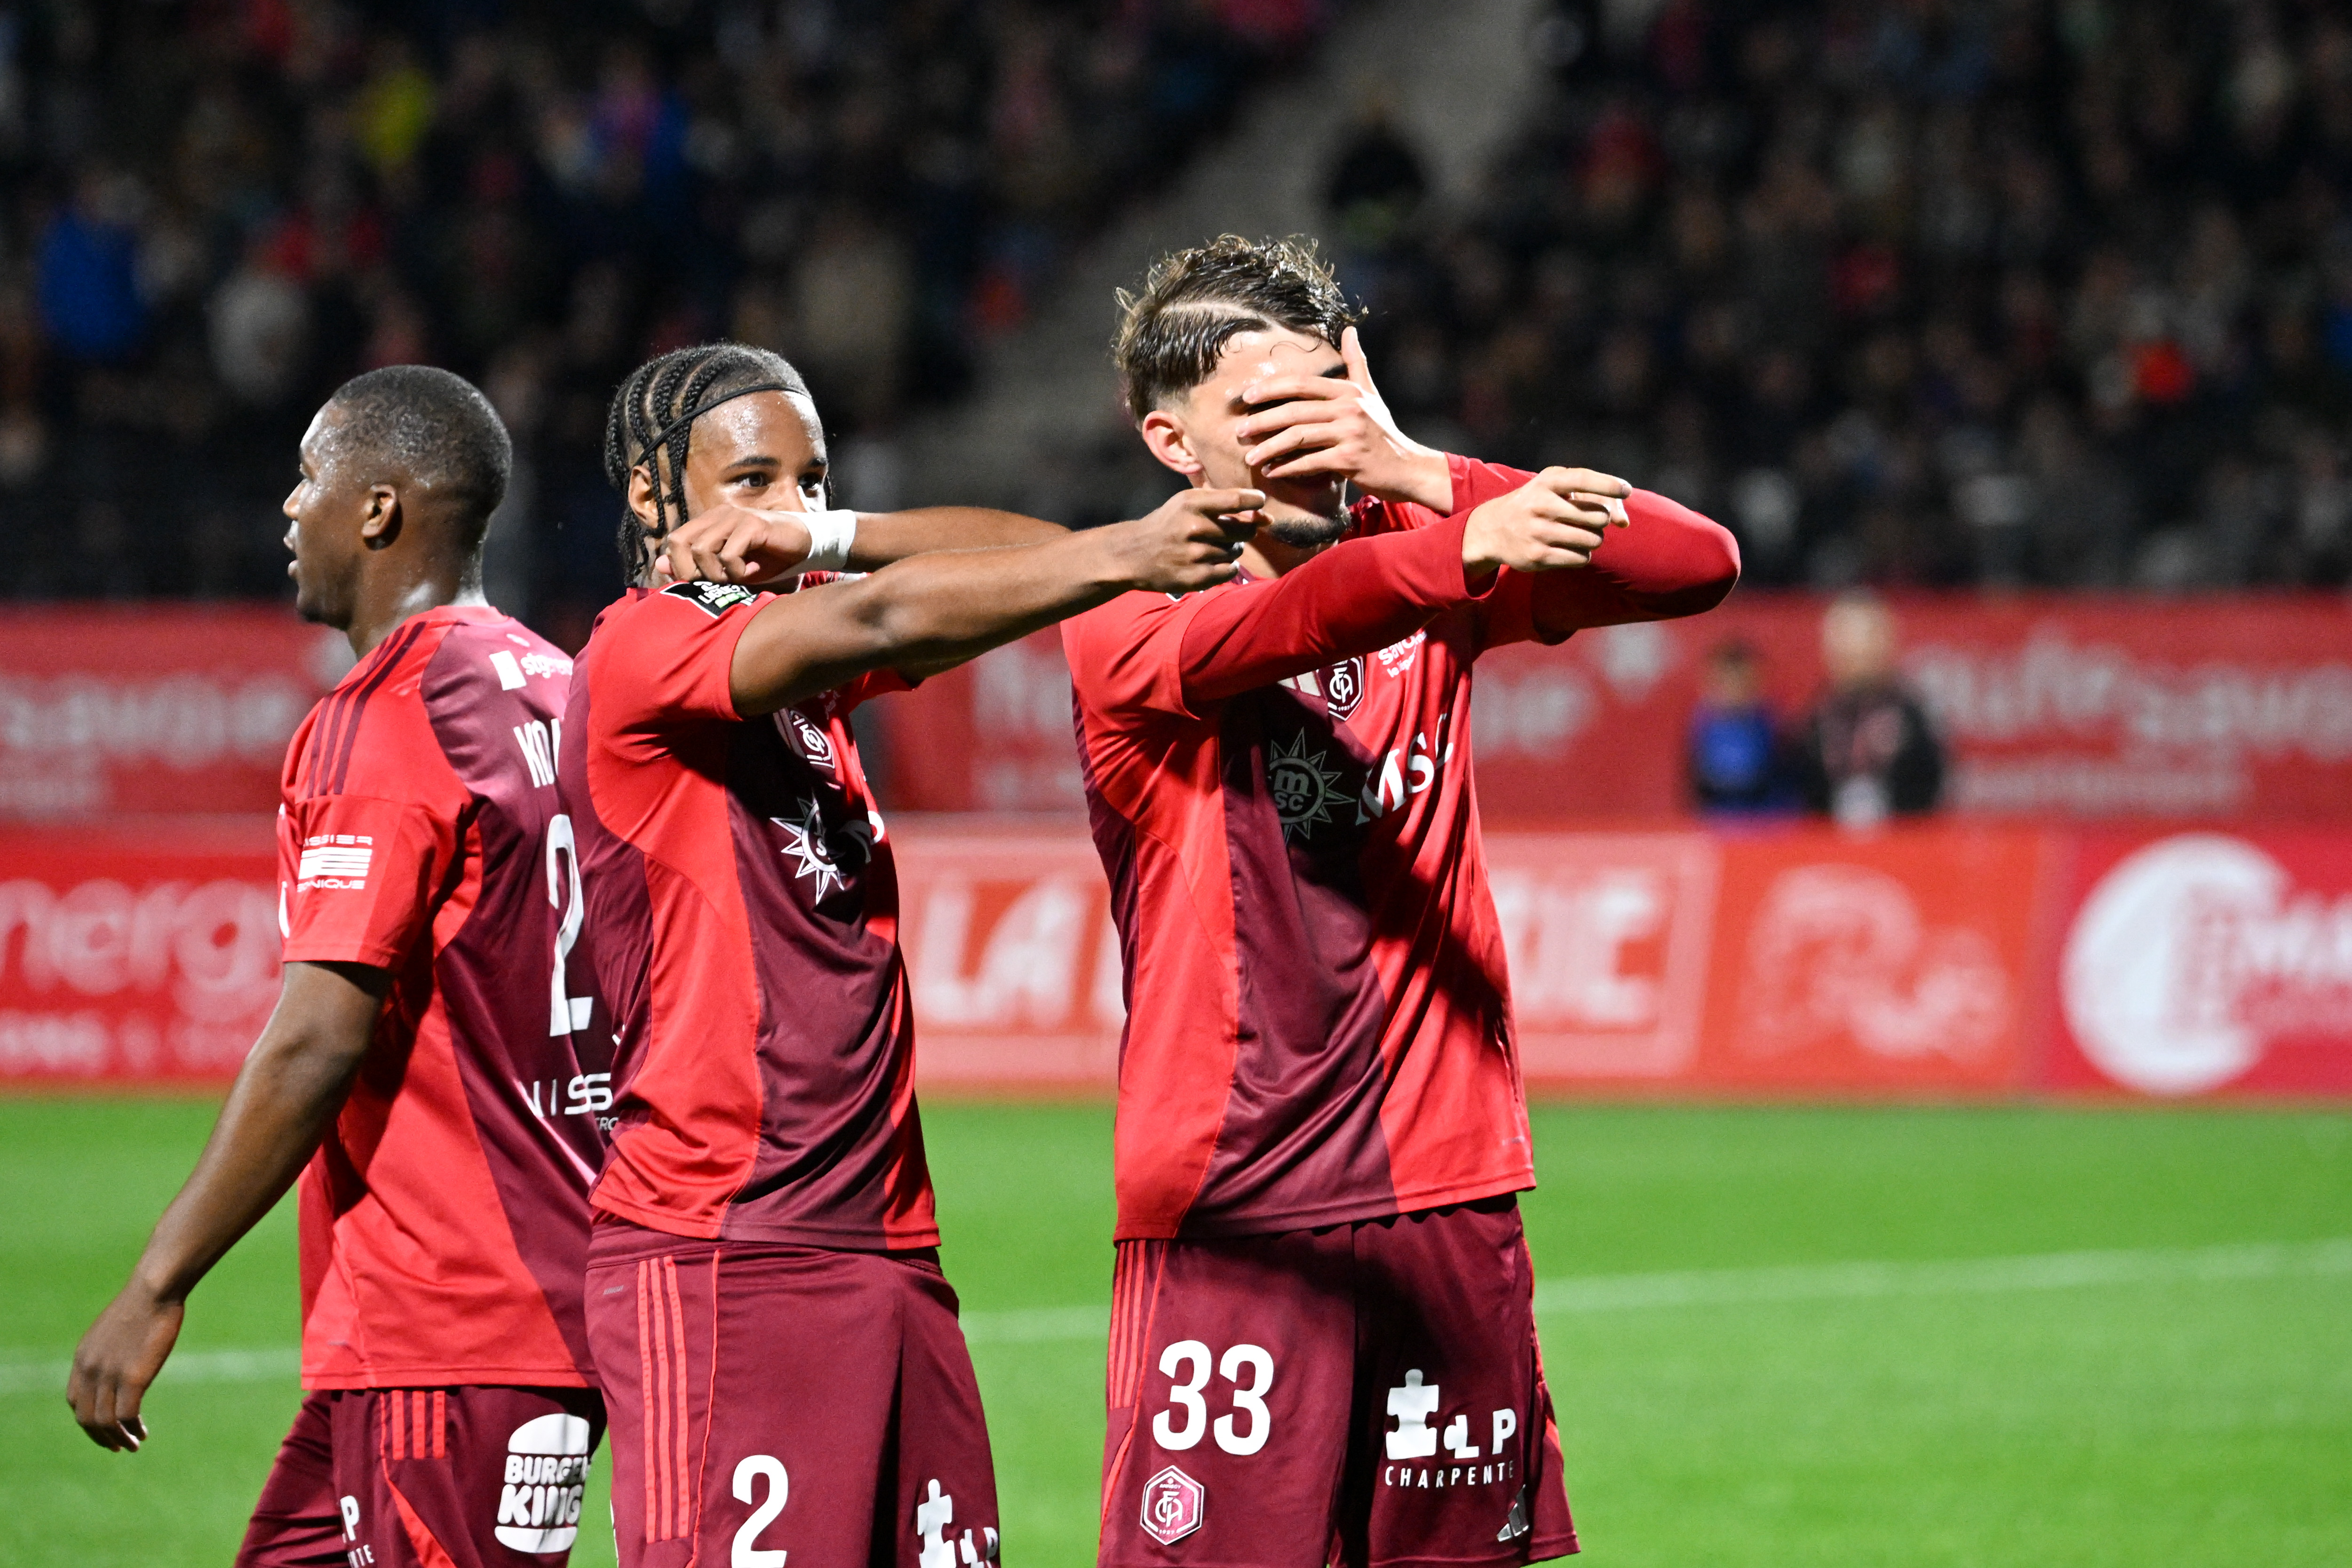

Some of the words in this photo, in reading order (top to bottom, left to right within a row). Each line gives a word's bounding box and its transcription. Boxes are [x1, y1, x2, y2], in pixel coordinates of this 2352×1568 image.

[546, 814, 594, 1037] 2
[1152, 1339, 1274, 1456] 33
[497, 1484, 583, 1527] KING
[731, 1454, 788, 1568] 2
[1385, 1460, 1514, 1488] CHARPENTE
